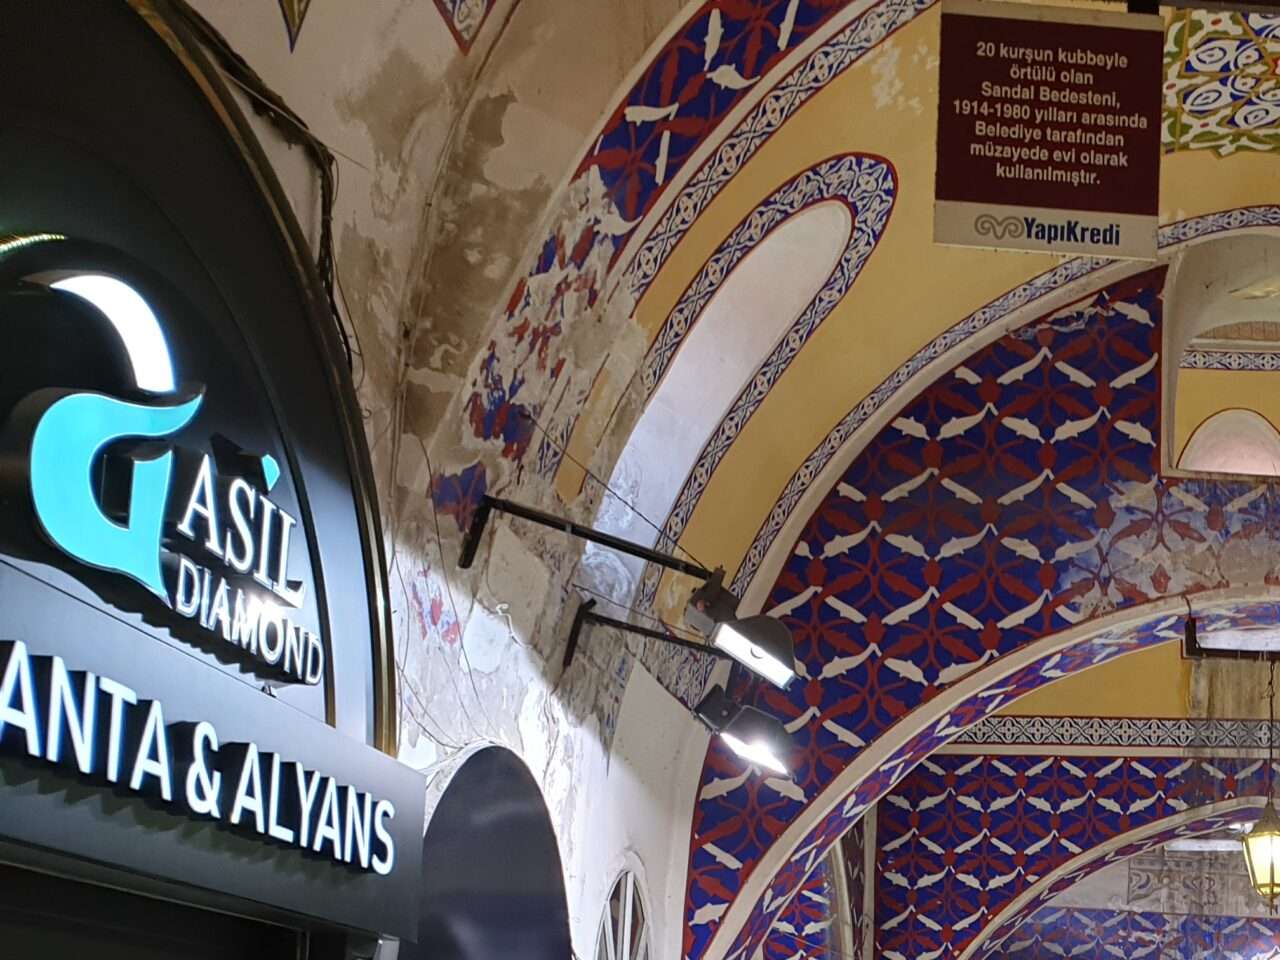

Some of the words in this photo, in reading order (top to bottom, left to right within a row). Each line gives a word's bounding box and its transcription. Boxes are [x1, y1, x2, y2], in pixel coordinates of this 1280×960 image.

[976, 41, 995, 57] 20
[999, 42, 1053, 63] kurşun
[1058, 48, 1128, 70] kubbeyle
[1010, 63, 1056, 82] örtülü
[1060, 68, 1094, 85] olan
[981, 81, 1034, 100] Sandal
[1039, 86, 1121, 109] Bedesteni,
[953, 99, 1030, 119] 1914-1980
[1035, 107, 1077, 124] yılları
[1081, 111, 1148, 129] arasında
[975, 121, 1042, 142] Belediye
[1046, 126, 1124, 147] tarafından
[970, 142, 1049, 162] müzayede
[1053, 148, 1076, 163] evi
[1080, 150, 1128, 167] olarak
[996, 163, 1101, 187] kullanılmıştır.
[1023, 216, 1121, 246] YapıKredi
[176, 557, 323, 686] DIAMOND
[186, 720, 221, 820] &
[231, 742, 395, 876] ALYANS
